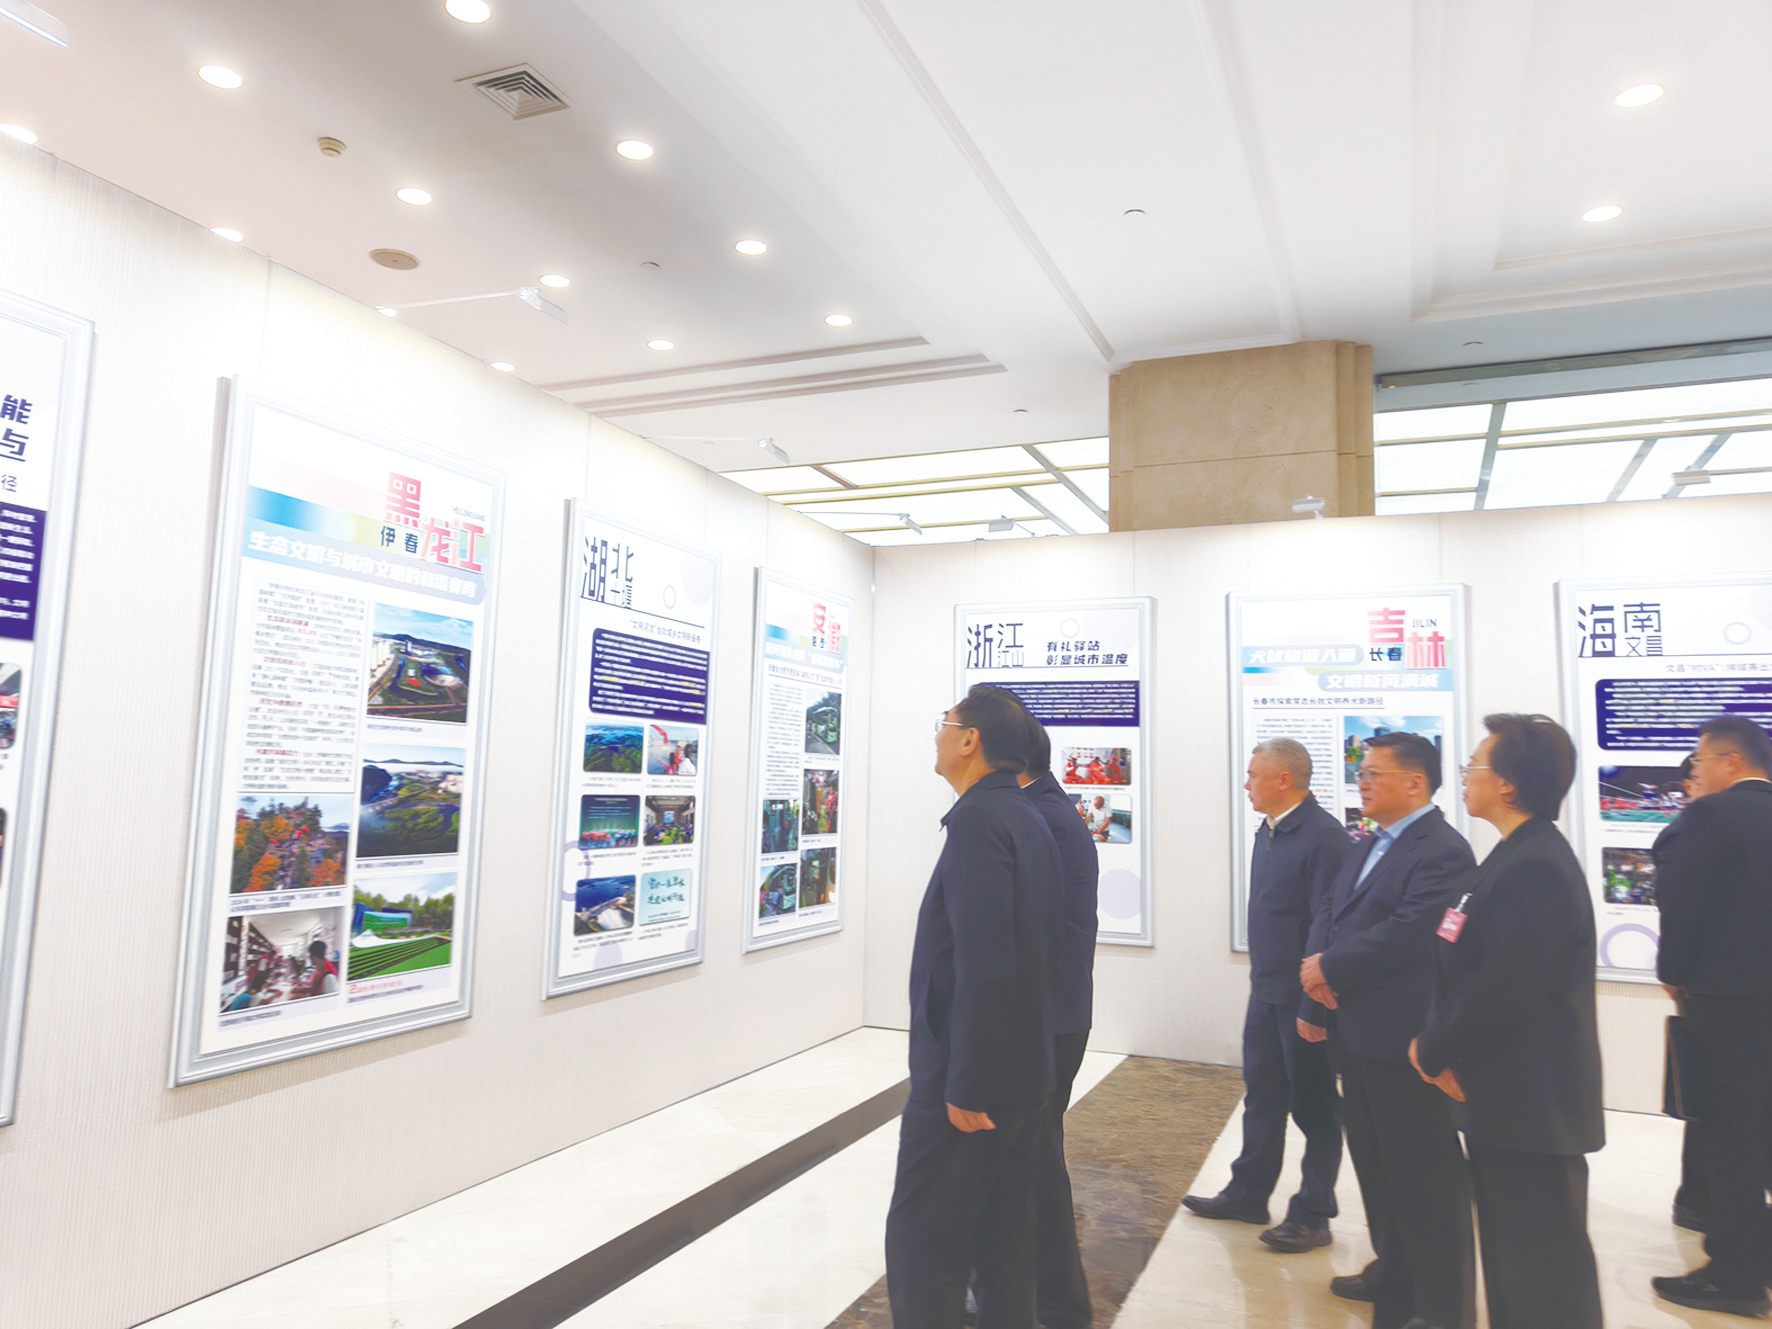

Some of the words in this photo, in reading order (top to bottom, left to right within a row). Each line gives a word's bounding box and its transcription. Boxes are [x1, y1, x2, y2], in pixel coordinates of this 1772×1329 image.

[0, 394, 33, 425] 能
[0, 428, 29, 464] 与
[380, 525, 418, 554] 伊春
[1412, 619, 1437, 627] JILIN
[1577, 602, 1662, 657] 海南
[967, 623, 1024, 668] 浙江
[1047, 641, 1100, 652] 有礼驿站
[1367, 608, 1445, 668] 吉林
[1625, 635, 1662, 657] 文昌
[1046, 653, 1128, 665] 彰显城市温度
[1370, 647, 1402, 661] 长春
